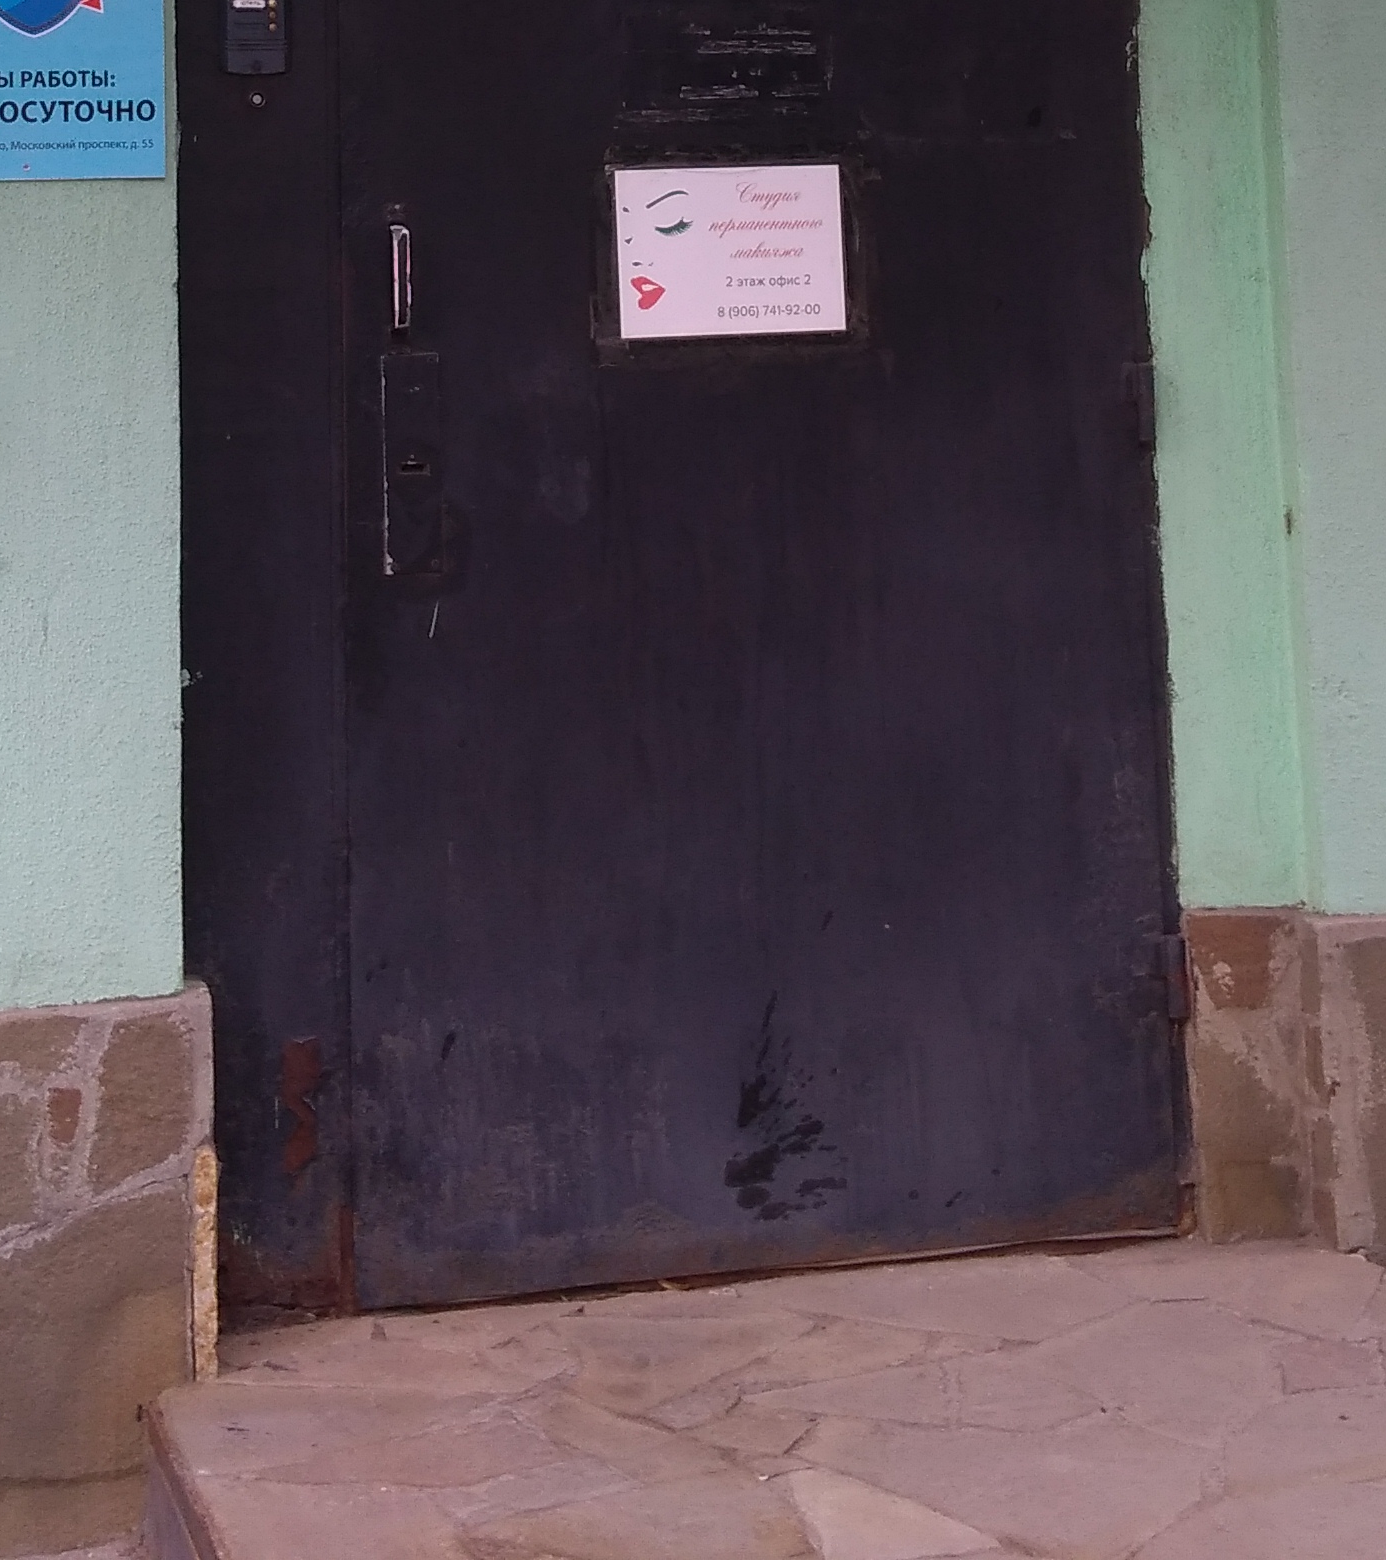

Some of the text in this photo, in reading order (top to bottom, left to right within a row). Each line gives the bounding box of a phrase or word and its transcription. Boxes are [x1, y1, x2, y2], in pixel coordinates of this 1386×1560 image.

[20, 69, 117, 89] РАБОТЫ:
[10, 137, 75, 151] Московский
[78, 140, 129, 151] проспект,
[141, 138, 154, 149] 55
[735, 181, 802, 211] Студия
[708, 217, 823, 239] перманентного
[729, 241, 805, 260] макияжа
[725, 274, 812, 290] 2 этаж офис 2
[717, 304, 821, 319] 8 (906) 741-92-00
